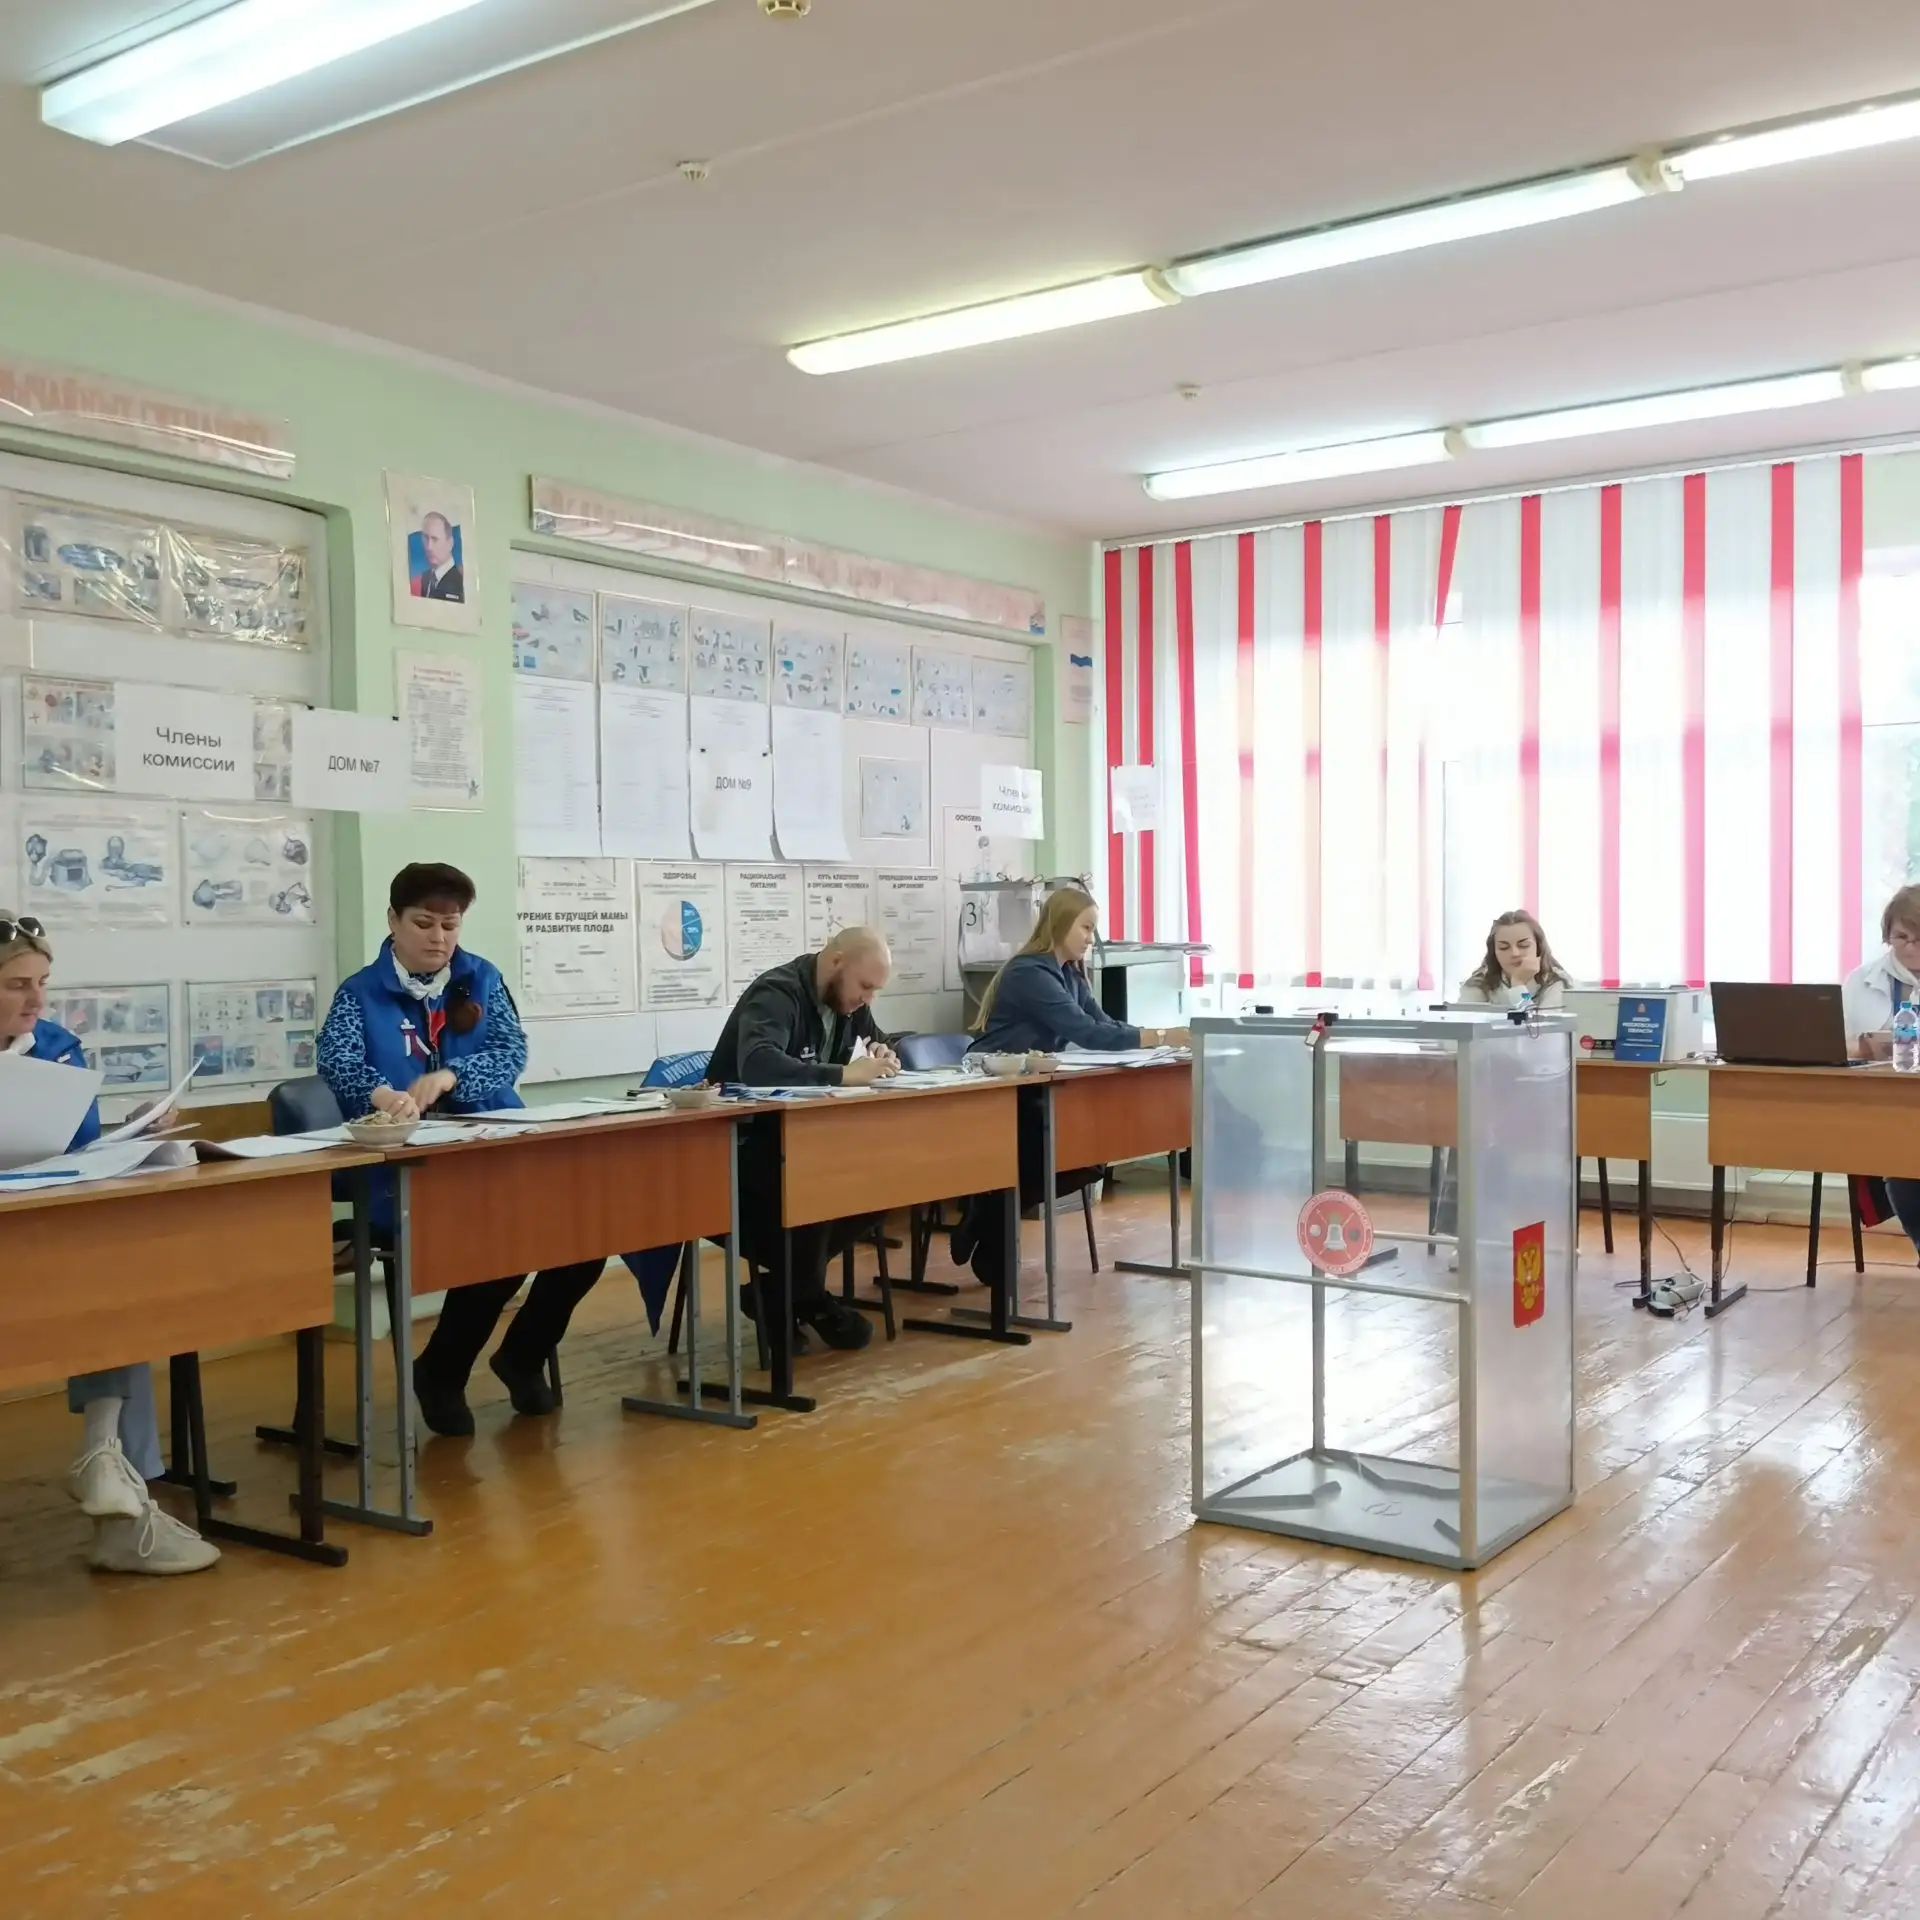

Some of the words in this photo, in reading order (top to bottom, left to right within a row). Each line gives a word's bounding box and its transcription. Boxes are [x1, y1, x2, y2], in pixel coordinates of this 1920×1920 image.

[156, 726, 221, 748] Члены
[143, 753, 235, 772] комиссии
[328, 755, 356, 772] ДОМ
[360, 758, 380, 774] №7
[715, 776, 736, 790] ДОМ
[974, 825, 982, 833] ТА
[516, 912, 553, 921] УРЕНИЕ
[554, 910, 598, 921] БУДУЩЕЙ
[601, 911, 629, 921] МАМЫ
[965, 902, 977, 927] 3
[526, 925, 534, 933] И
[535, 924, 582, 933] РАЗВИТИЕ
[583, 924, 615, 933] ПЛОДА
